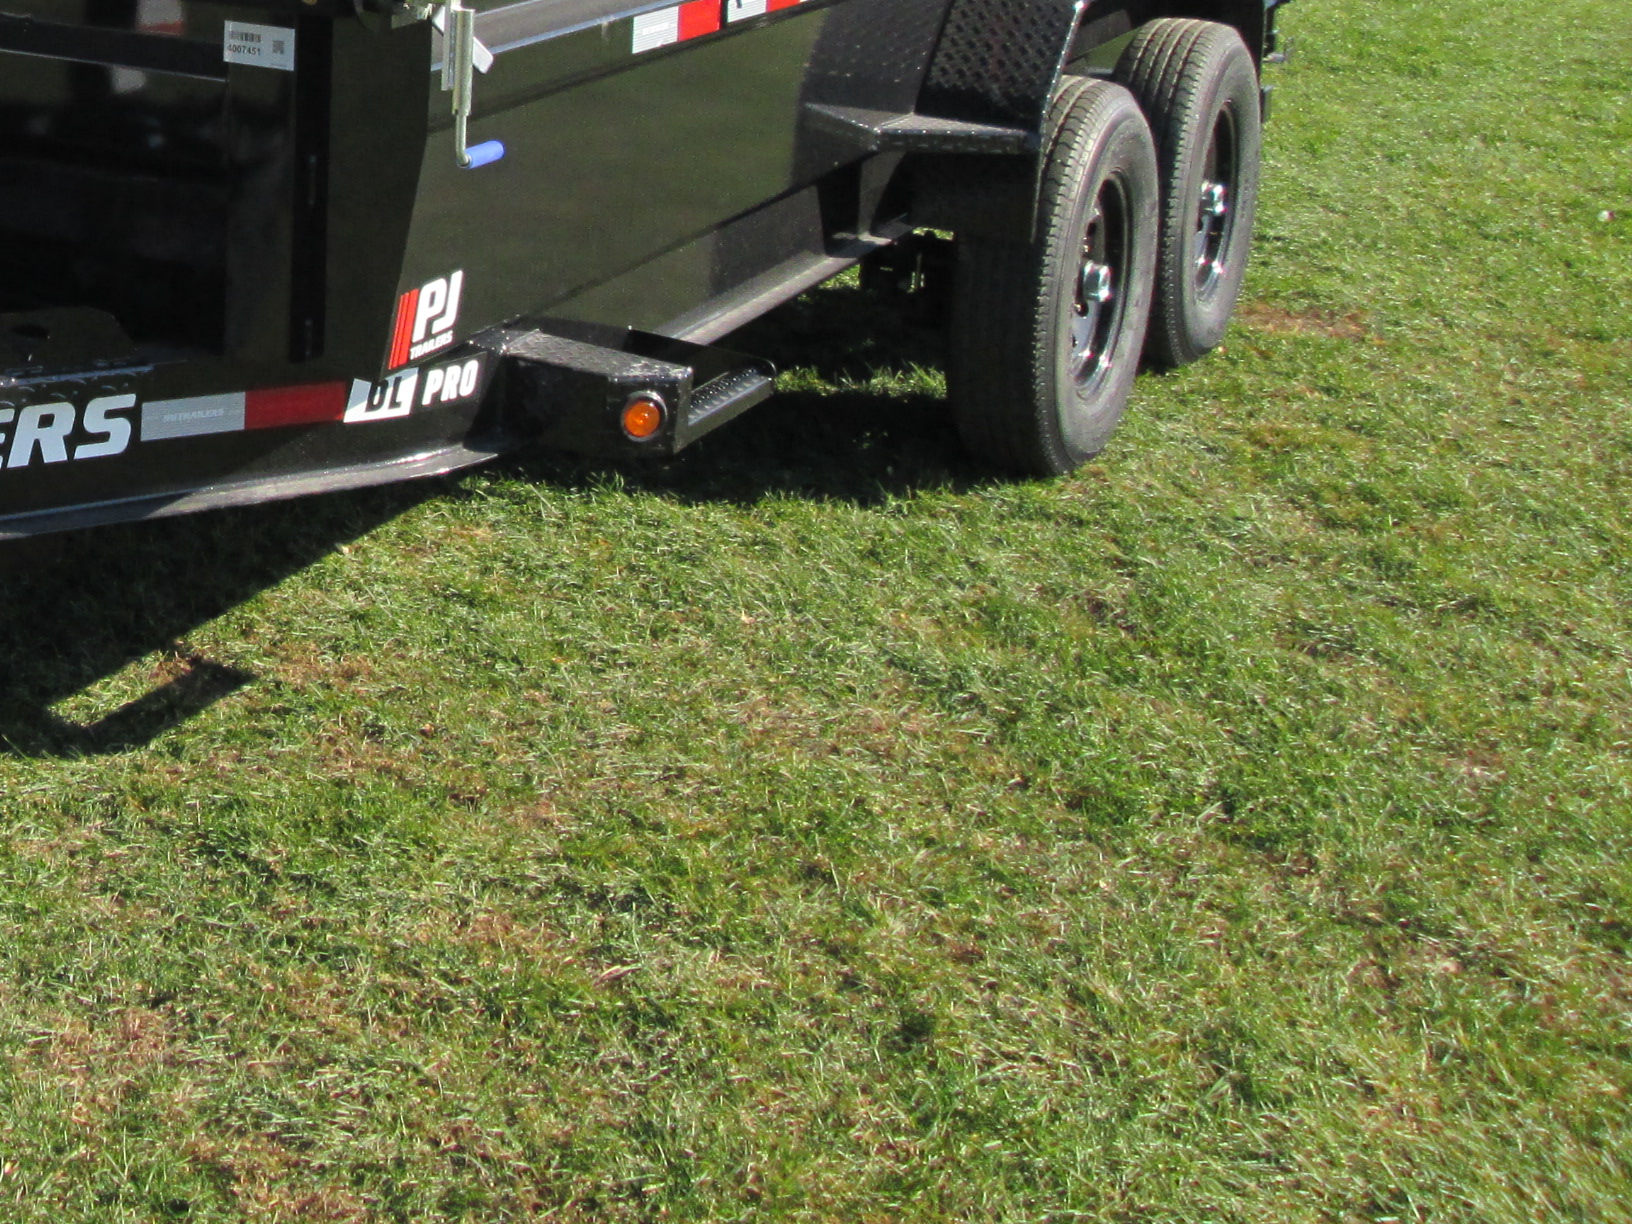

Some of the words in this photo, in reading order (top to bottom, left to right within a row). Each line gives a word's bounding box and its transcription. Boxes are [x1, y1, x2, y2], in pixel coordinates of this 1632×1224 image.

[227, 43, 261, 56] 4007451
[412, 270, 463, 343] PJ
[410, 330, 454, 360] TRAILERS
[422, 359, 479, 406] PRO
